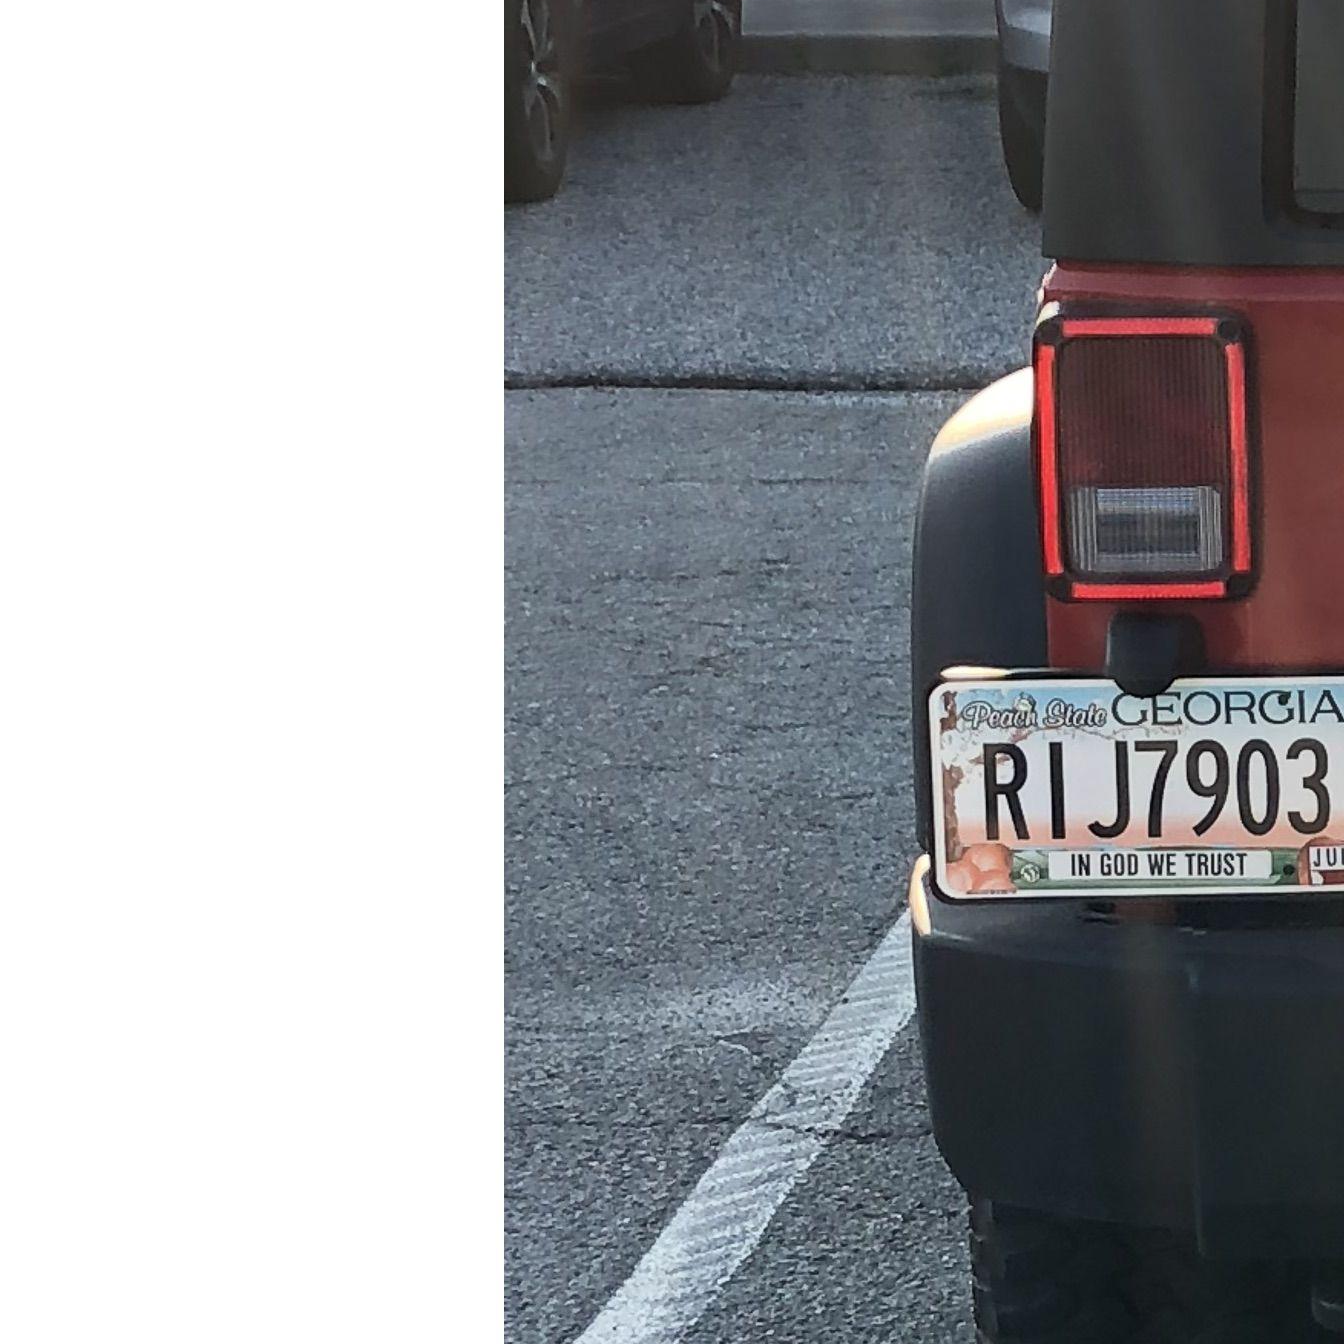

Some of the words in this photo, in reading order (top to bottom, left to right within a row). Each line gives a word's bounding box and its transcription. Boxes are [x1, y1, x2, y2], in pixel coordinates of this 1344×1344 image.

[961, 698, 1038, 730] Peach
[1043, 697, 1108, 728] State
[1070, 853, 1091, 877] IN
[1100, 853, 1139, 877] GOD
[1147, 853, 1177, 876] WE
[1185, 853, 1248, 876] TRUST
